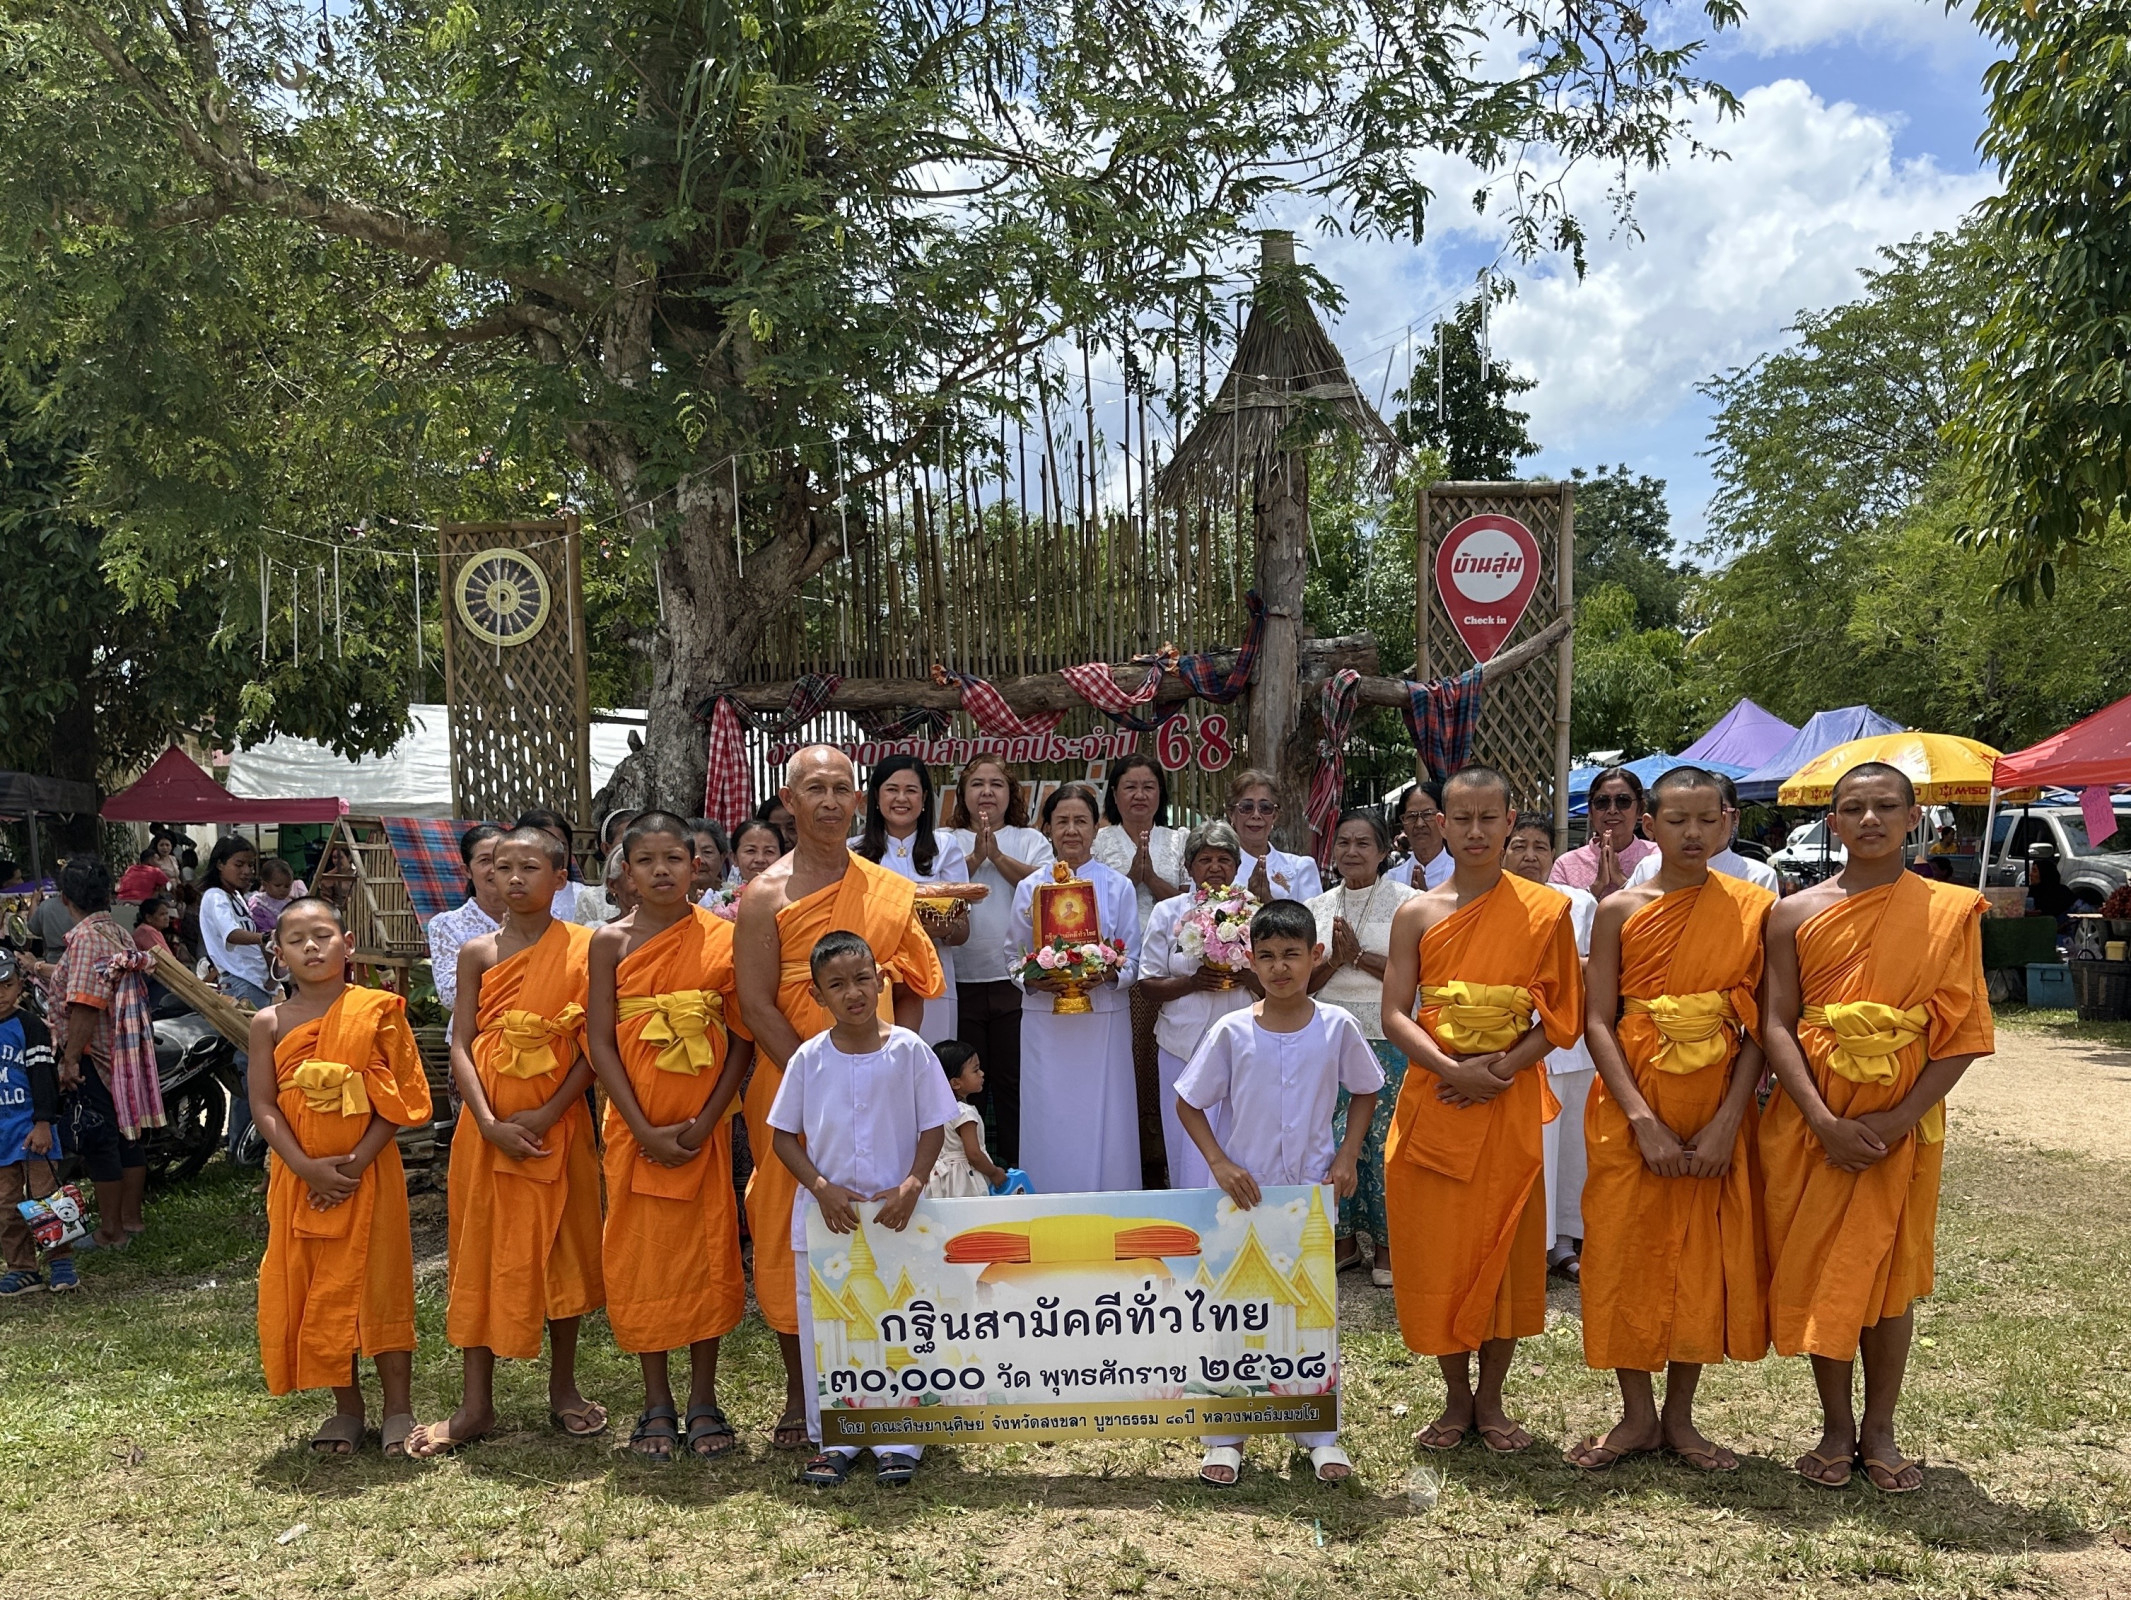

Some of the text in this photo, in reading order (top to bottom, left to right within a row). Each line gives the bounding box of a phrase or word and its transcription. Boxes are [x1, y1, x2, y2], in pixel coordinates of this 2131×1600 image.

[1453, 552, 1523, 579] บ้านลุ่ม
[1464, 615, 1507, 625] Check in
[1155, 712, 1233, 773] 68
[880, 1280, 1270, 1355] กฐินสามัคคีทั่วไทย
[830, 1351, 1327, 1398] ๓๐,๐๐๐ วัด พุทธศักราช ๒๕๖๘
[837, 1416, 865, 1434] โดย
[872, 1410, 985, 1437] คณะศิษยานุศิษย์
[991, 1409, 1087, 1432] จังหวัดสงขลา
[1094, 1412, 1159, 1433] บูชาธรรม
